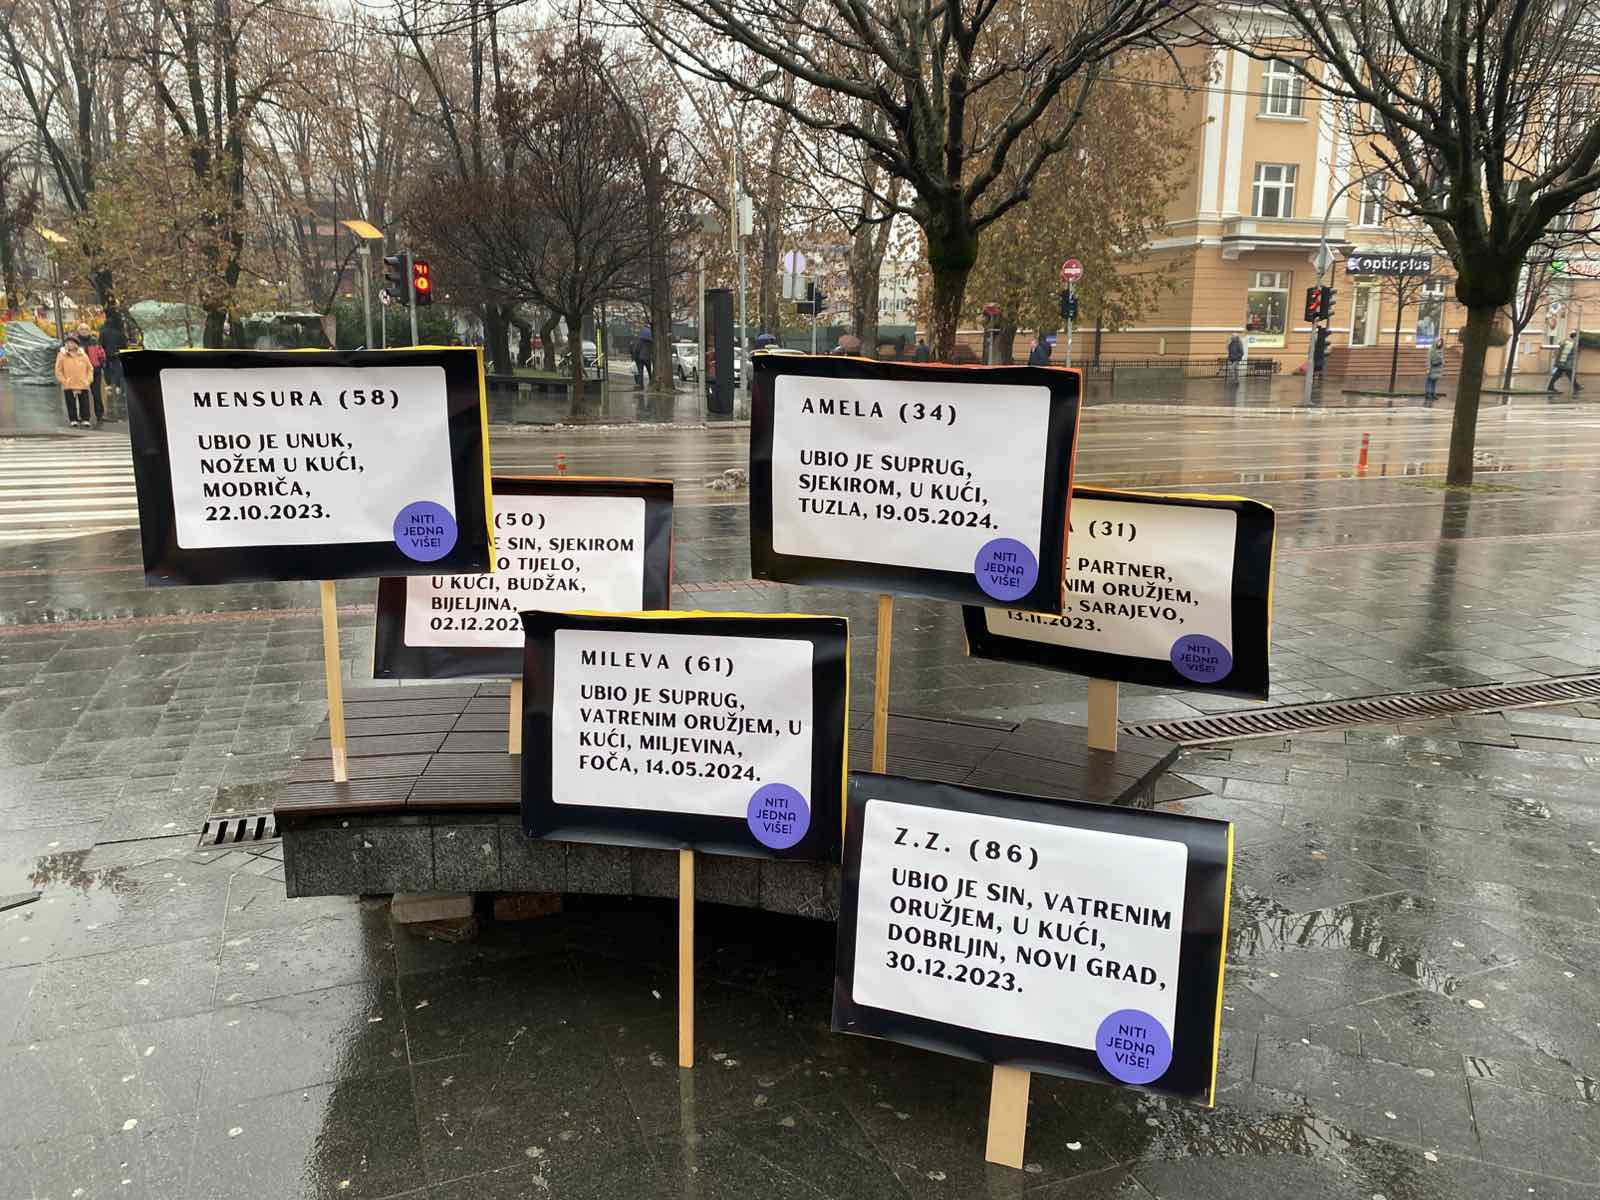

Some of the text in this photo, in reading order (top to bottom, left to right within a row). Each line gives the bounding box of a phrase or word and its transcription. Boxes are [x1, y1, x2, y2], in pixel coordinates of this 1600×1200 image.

[194, 390, 398, 409] MENSURA (58)
[802, 398, 956, 425] AMELA (34)
[199, 433, 352, 452] UBIO JE UNUK,
[201, 451, 363, 474] NOŽEM U KUĆI,
[801, 450, 971, 479] UBIO JE SUPRUG,
[204, 478, 310, 497] MODRIČA,
[799, 474, 987, 506] SJEKIROM, U KUĆI,
[206, 504, 330, 520] 22.10.2023.
[411, 515, 434, 523] NITI
[495, 513, 545, 529] (50)
[799, 498, 997, 529] TUZLA, 19.05.2024.
[403, 527, 444, 538] JEDNA
[1089, 521, 1136, 542] (31)
[412, 536, 440, 547] VIŠE!
[508, 537, 541, 552] SIN,
[550, 538, 633, 553] SJEKIROM
[518, 558, 580, 573] TIJELO,
[992, 552, 1016, 564] NITI
[984, 563, 1024, 577] JEDNA
[1079, 558, 1172, 584] PARTNER,
[432, 574, 585, 592] U KUĆI, BUDŽAK,
[991, 575, 1019, 587] VIŠE!
[1103, 580, 1198, 607] ORUŽJEM,
[432, 597, 517, 612] BIJELJINA,
[1080, 600, 1184, 623] SARAJEVO,
[431, 617, 525, 632] 02.12.202
[1187, 645, 1210, 655] NITI
[582, 650, 733, 677] MILEVA (61)
[1180, 654, 1218, 666] JEDNA
[1187, 663, 1215, 672] VIŠE!
[582, 685, 744, 711] UBIO JE SUPRUG,
[580, 708, 801, 736] VATRENIM ORUŽJEM, U
[580, 729, 742, 758] KUĆI, MILJEVINA,
[580, 752, 760, 781] FOČA, 14.05.2024.
[766, 798, 788, 808] NITI
[756, 809, 796, 822] JEDNA
[763, 821, 791, 834] VIŠE!
[894, 828, 1038, 870] Z.Z. (86)
[893, 868, 1171, 931] UBIO JE SIN, VATRENIM
[889, 895, 1105, 952] ORUŽJEM, U KUĆI,
[887, 923, 1165, 990] DOBRLJIN, NOVI GRAD,
[886, 950, 1025, 992] 30.12.2023.
[1118, 1025, 1146, 1040] NITI
[1106, 1038, 1154, 1055] JEDNA
[1115, 1052, 1150, 1069] VIŠE!
